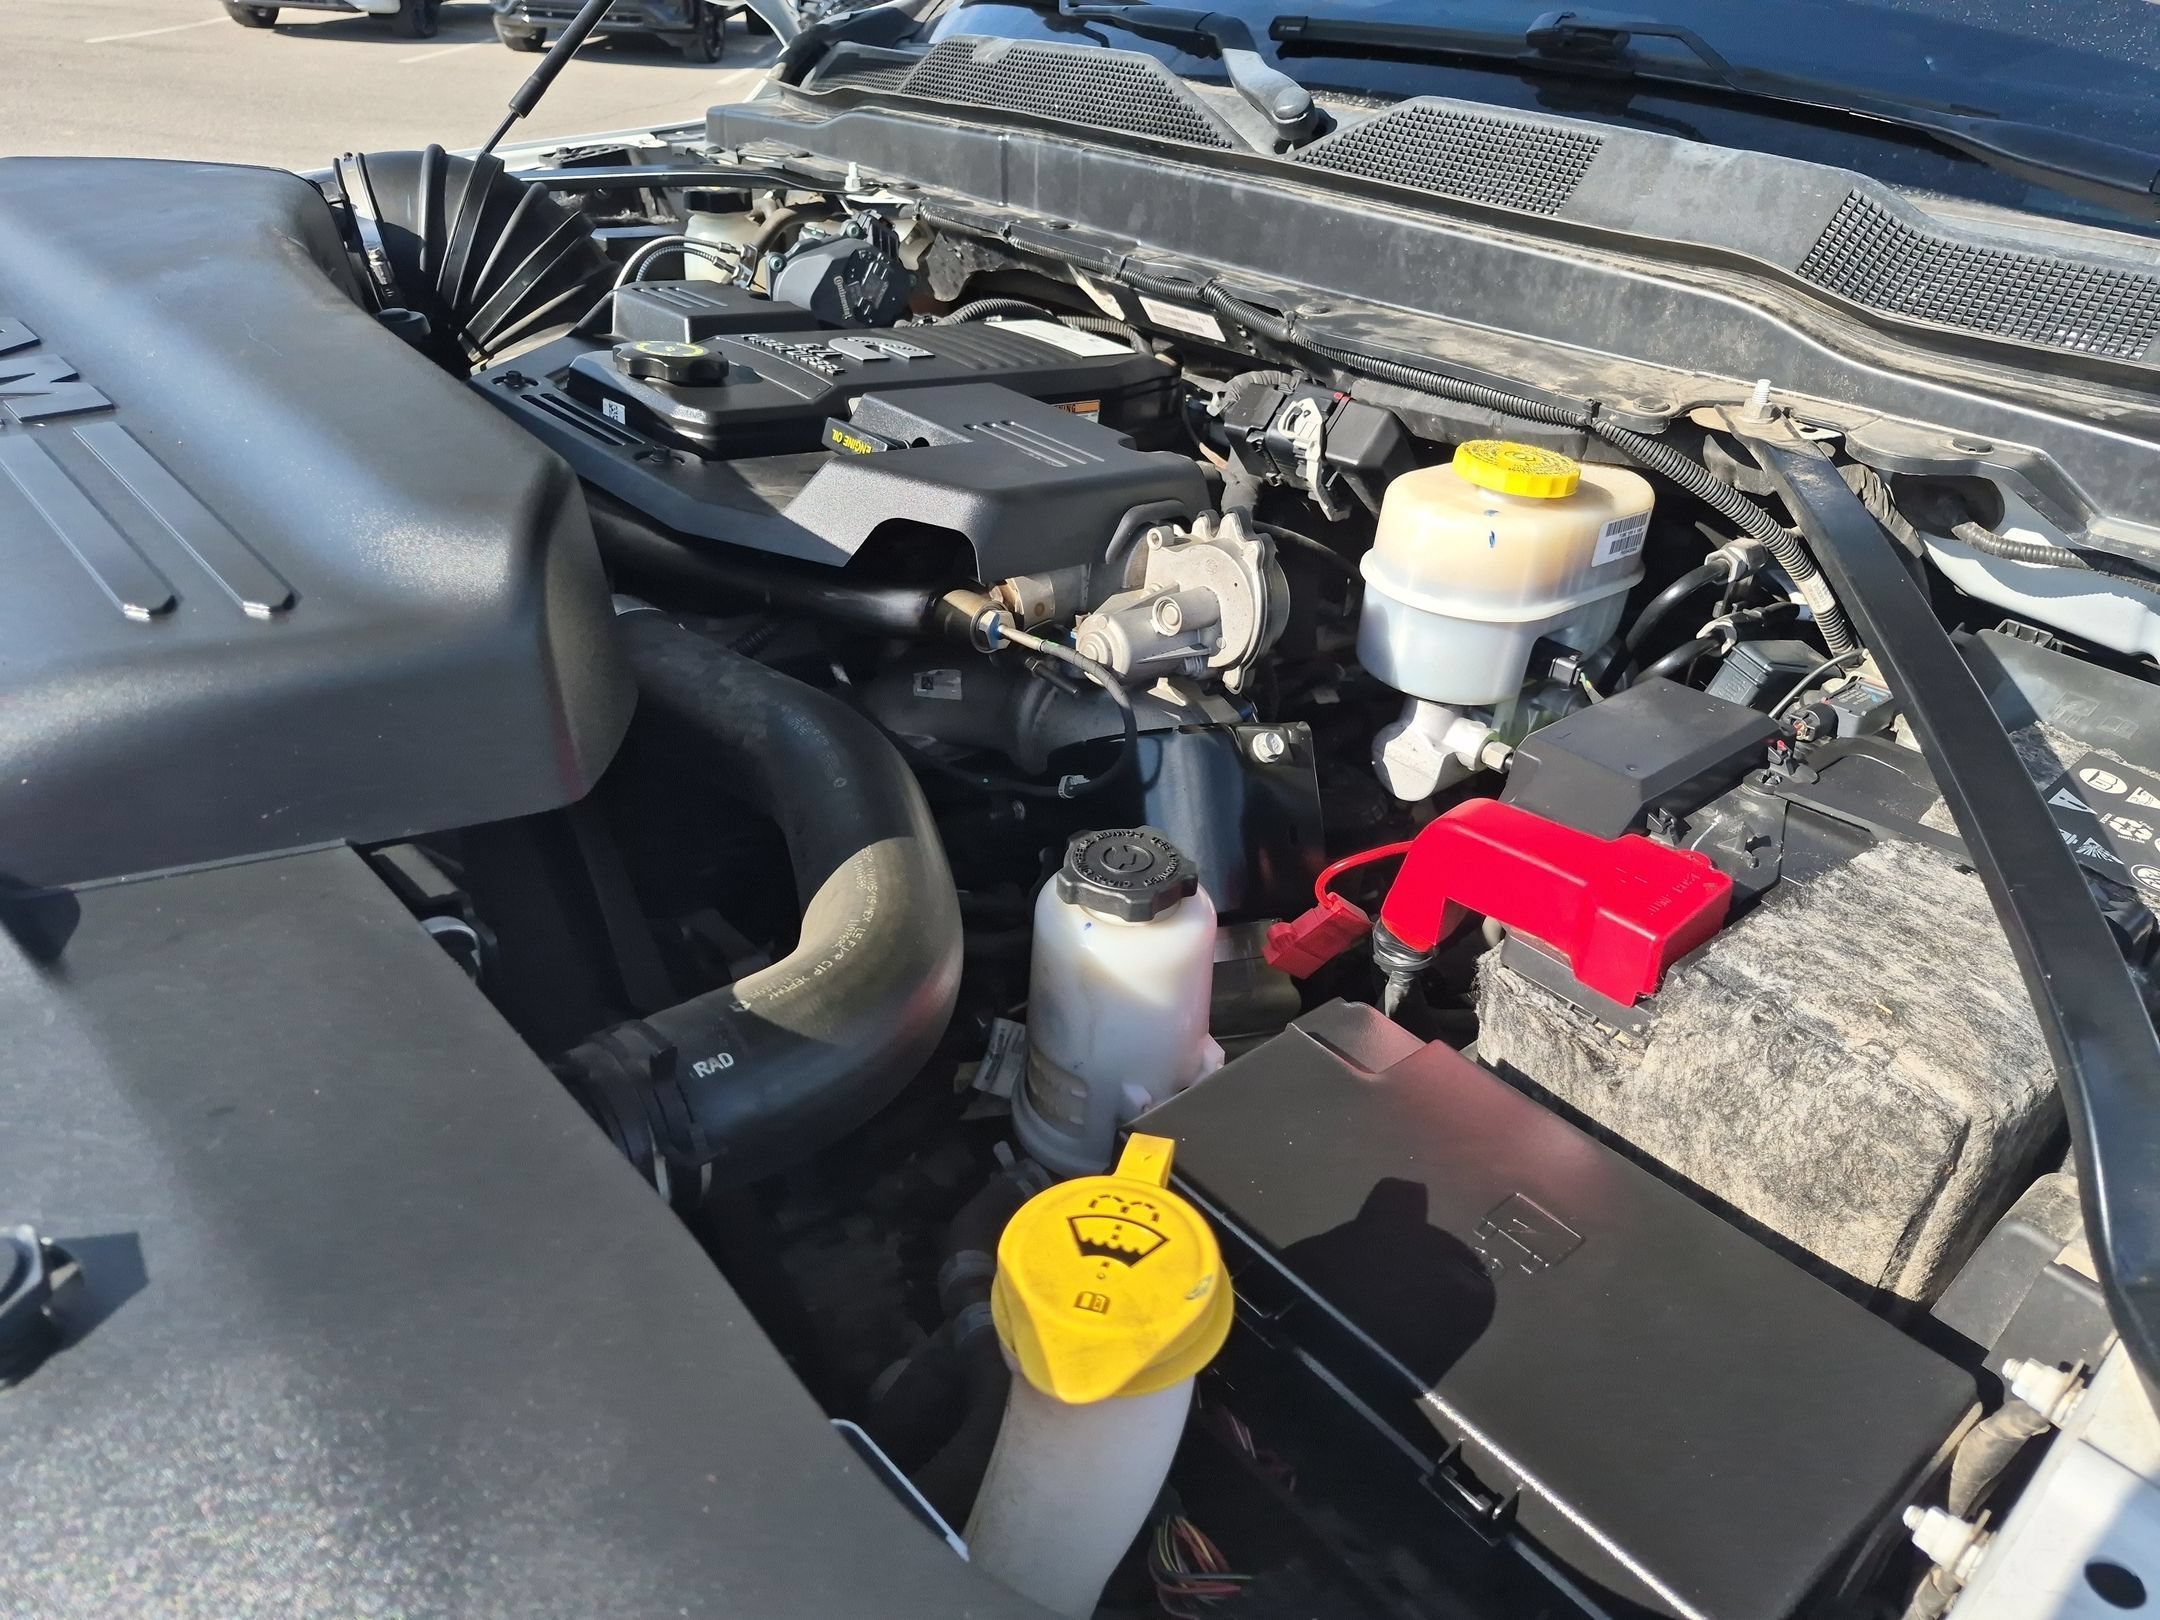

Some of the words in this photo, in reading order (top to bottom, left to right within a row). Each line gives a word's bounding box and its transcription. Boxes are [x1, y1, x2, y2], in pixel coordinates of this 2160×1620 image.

[834, 276, 852, 319] Continental
[832, 428, 843, 443] OIL
[842, 435, 873, 454] ENGINE
[692, 1052, 734, 1078] RAD
